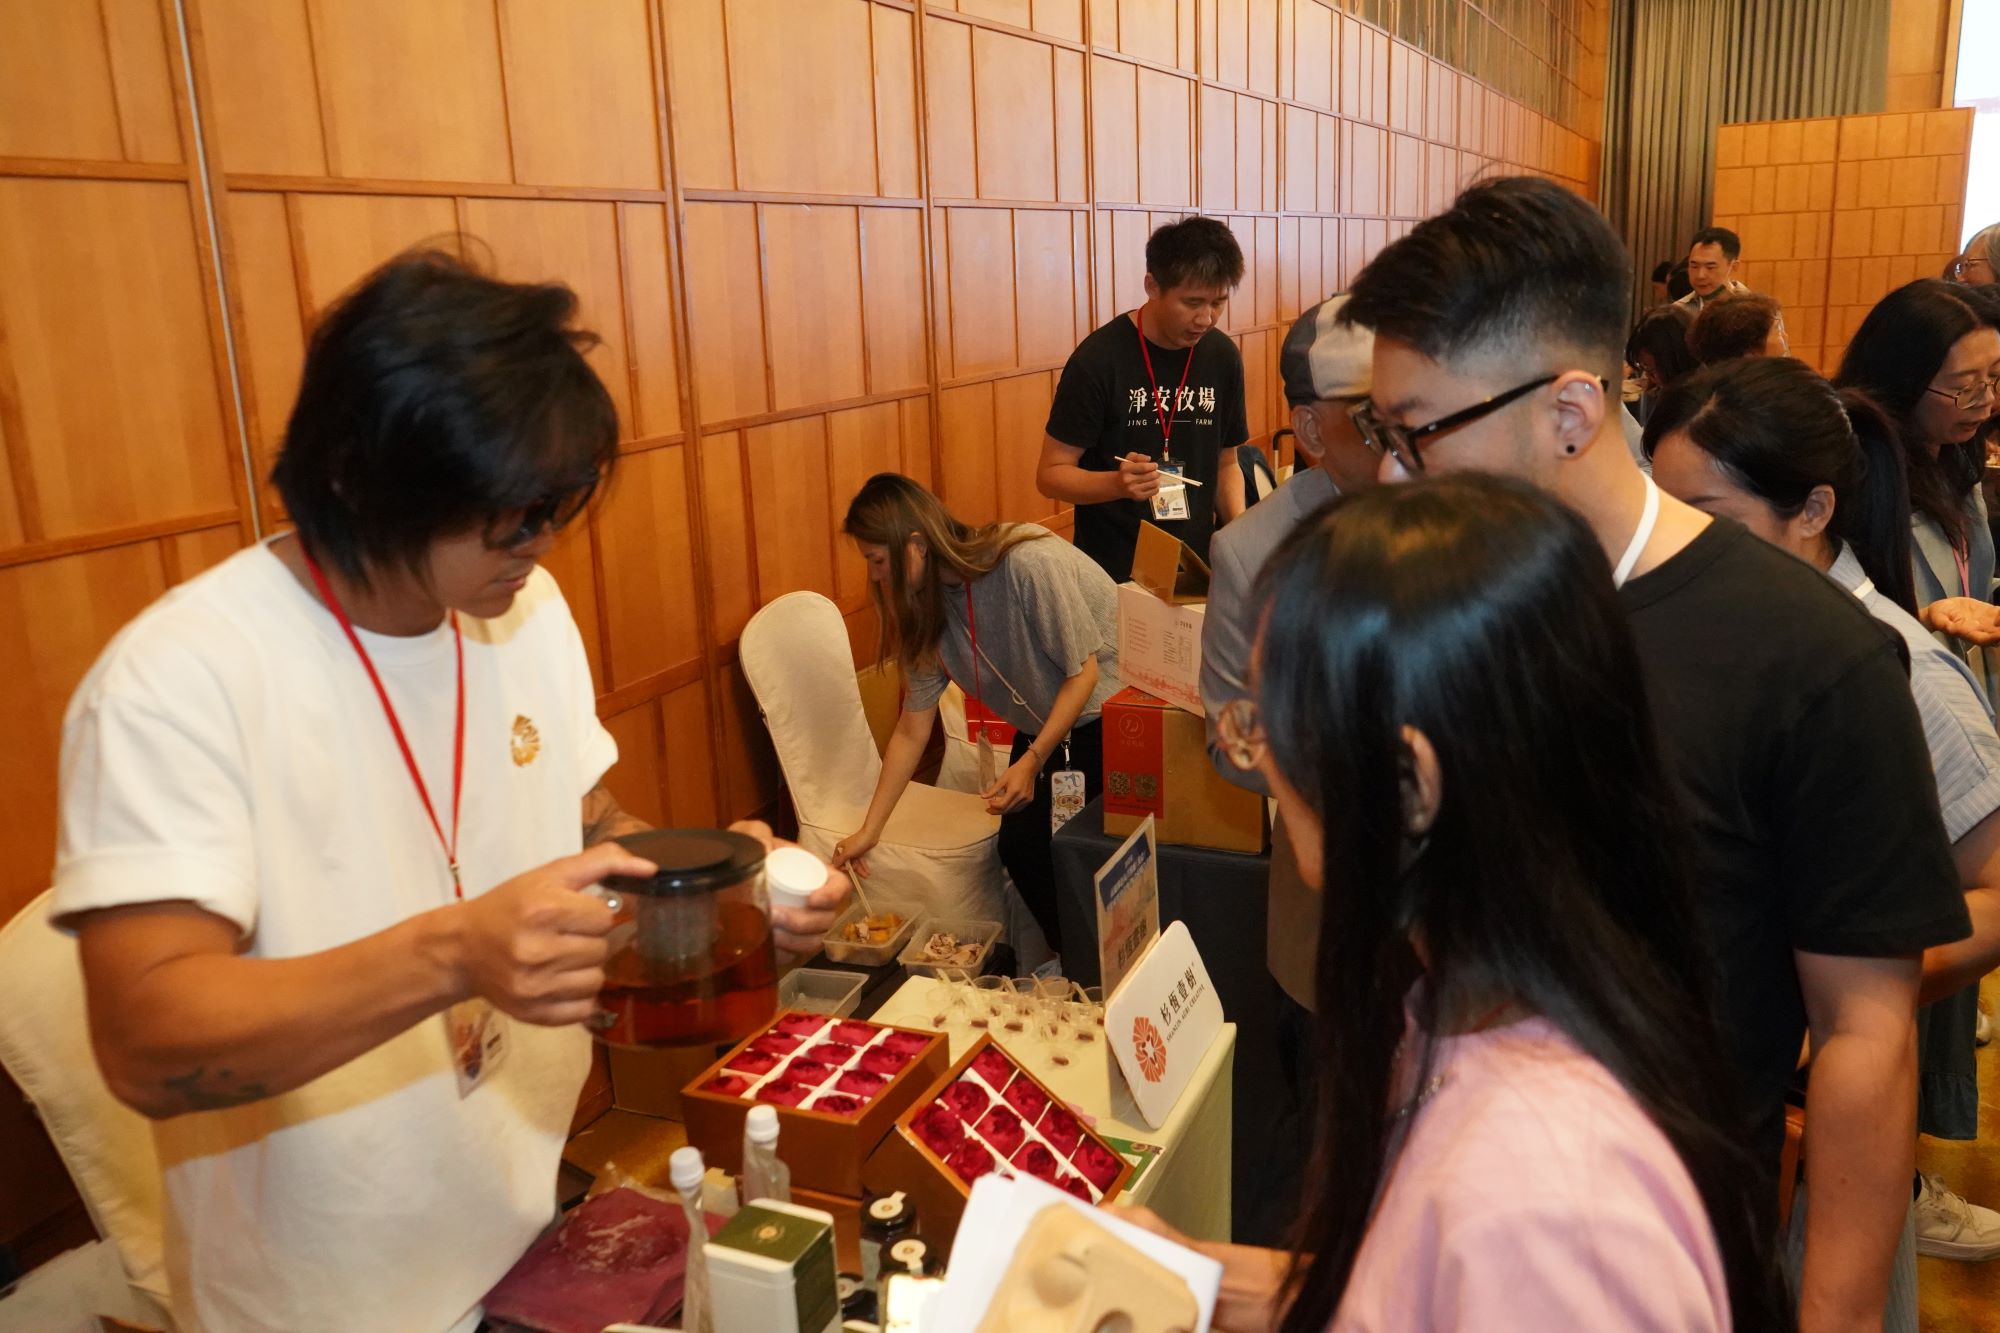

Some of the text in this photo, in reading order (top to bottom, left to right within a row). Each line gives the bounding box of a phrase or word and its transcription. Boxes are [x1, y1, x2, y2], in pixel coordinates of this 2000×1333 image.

[1128, 386, 1216, 414] 淨安牧場
[1127, 419, 1148, 427] JING
[1195, 418, 1213, 426] FARM
